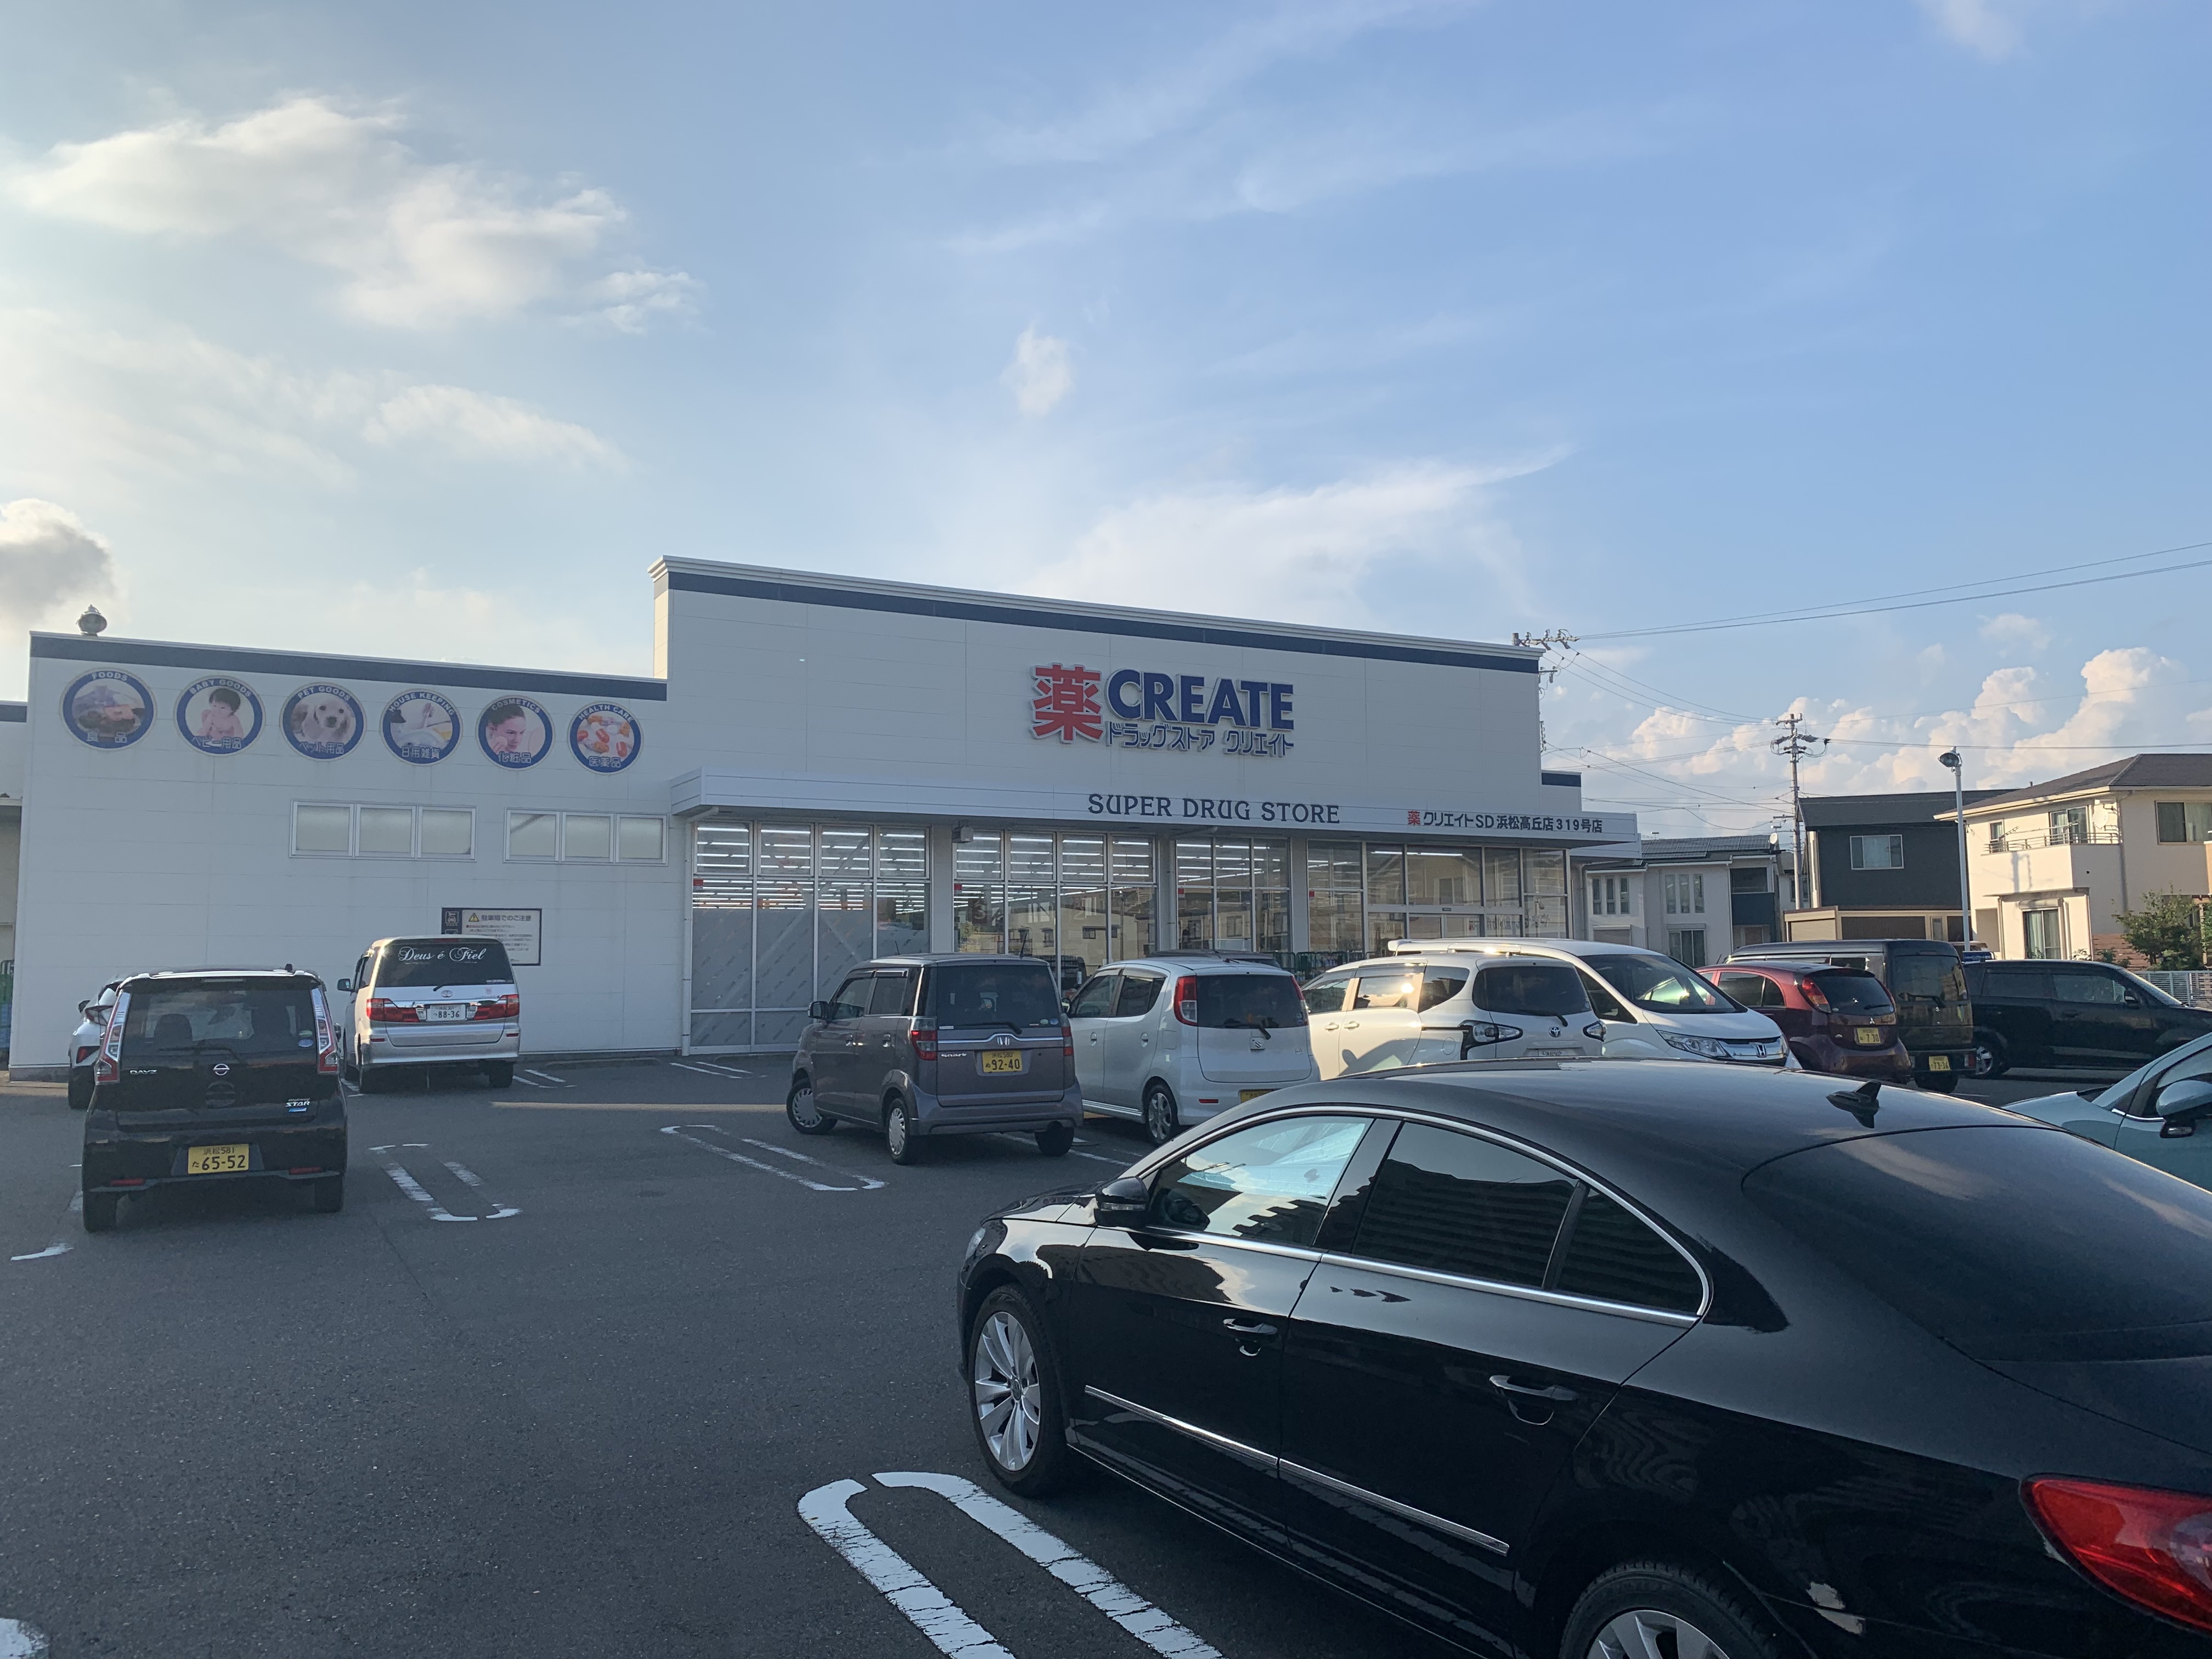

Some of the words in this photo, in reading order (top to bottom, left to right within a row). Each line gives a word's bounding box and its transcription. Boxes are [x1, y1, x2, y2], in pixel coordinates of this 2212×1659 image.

[92, 672, 128, 681] FOODS
[189, 680, 215, 695] BABY
[219, 679, 252, 697] GOODS
[297, 687, 314, 699] PET
[319, 686, 351, 701] GOODS
[388, 693, 416, 713] HOUSE
[419, 692, 455, 716] KEEPING
[492, 698, 541, 713] COSMETICS
[1030, 663, 1105, 743] 薬
[1105, 668, 1295, 730] CREATE
[578, 705, 610, 720] HEALTH
[613, 707, 634, 723] CARE
[192, 736, 242, 749] ベビー用品
[1106, 721, 1215, 752] ドラッグストア
[1224, 730, 1294, 757] クリエイト
[300, 742, 345, 754] ペット用品
[402, 747, 441, 759] 日用雑貨
[498, 752, 531, 764] 化粧品
[589, 757, 621, 768] 医薬品
[1088, 793, 1172, 817] SUPER
[1183, 798, 1250, 820] DRUG
[1261, 802, 1340, 823] STORE
[398, 946, 434, 961] Deus
[437, 951, 445, 960] é
[449, 947, 487, 962] Fiel
[991, 1058, 1020, 1071] 92-40
[201, 1154, 246, 1171] 65-52
